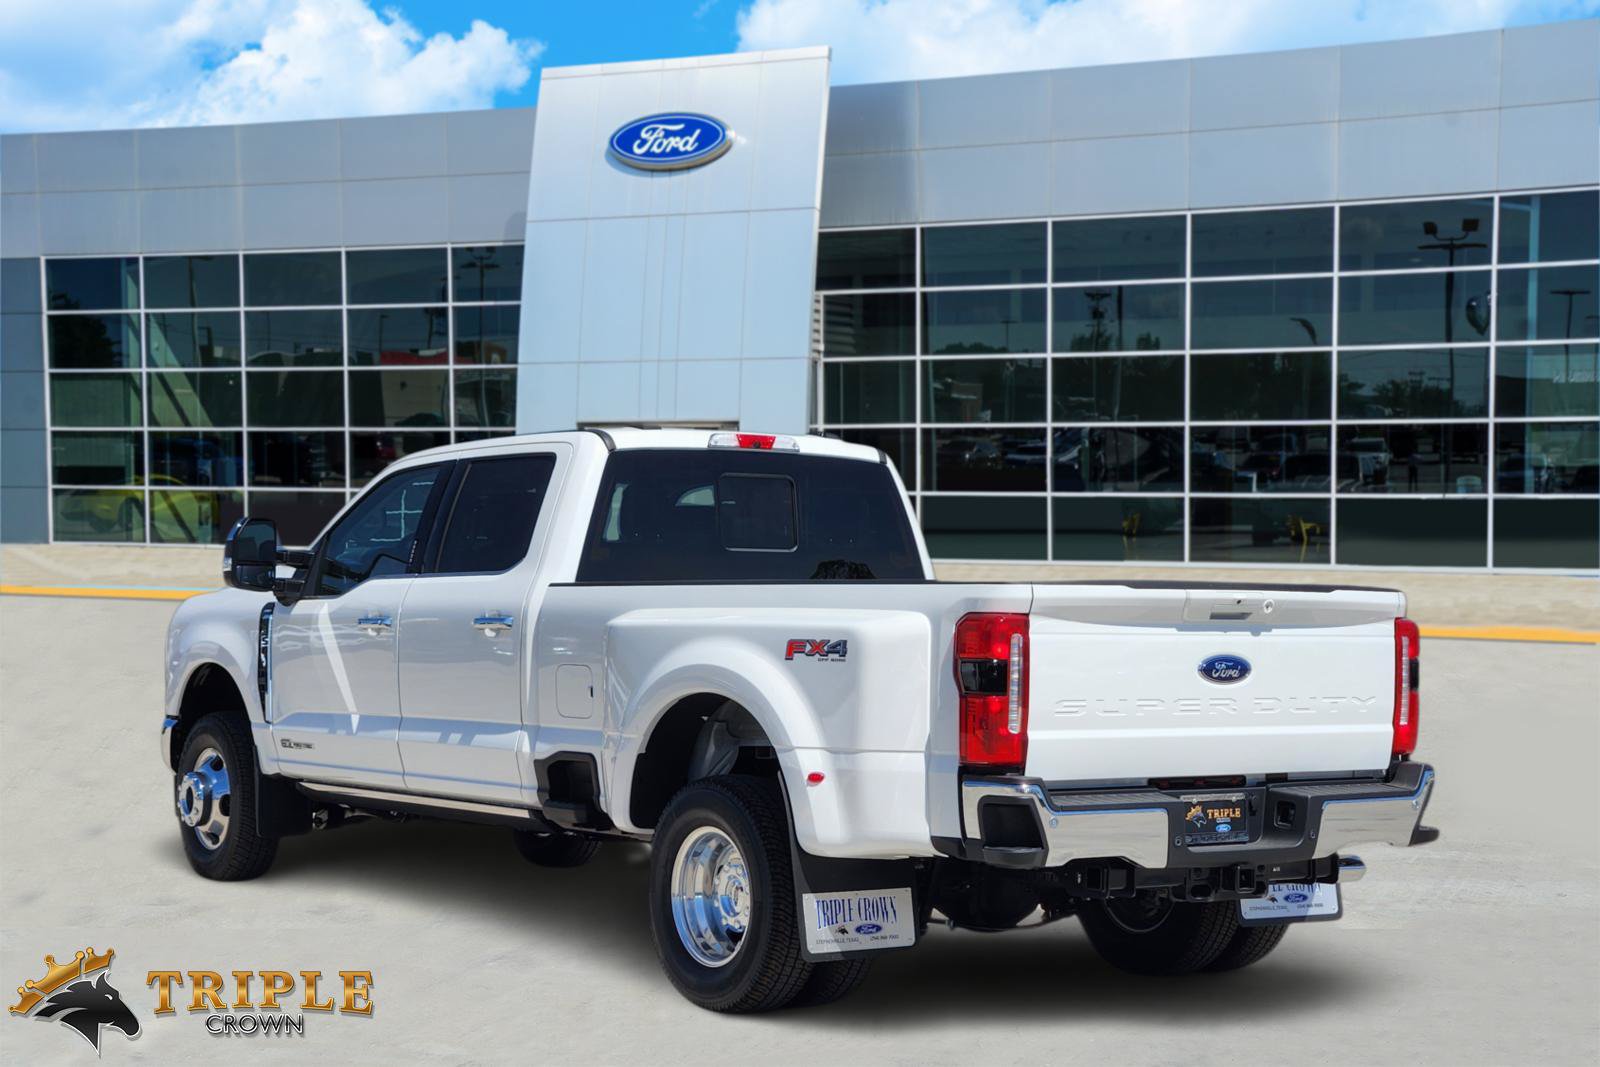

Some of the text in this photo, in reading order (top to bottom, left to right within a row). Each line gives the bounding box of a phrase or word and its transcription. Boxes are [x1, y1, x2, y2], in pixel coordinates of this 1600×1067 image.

[633, 123, 701, 155] Ford
[784, 639, 848, 661] FX4
[1212, 661, 1241, 678] Ford
[1053, 695, 1377, 717] SUPER DUTY
[1206, 807, 1241, 820] TRIPLE
[815, 895, 898, 929] TRIPLE CROWN
